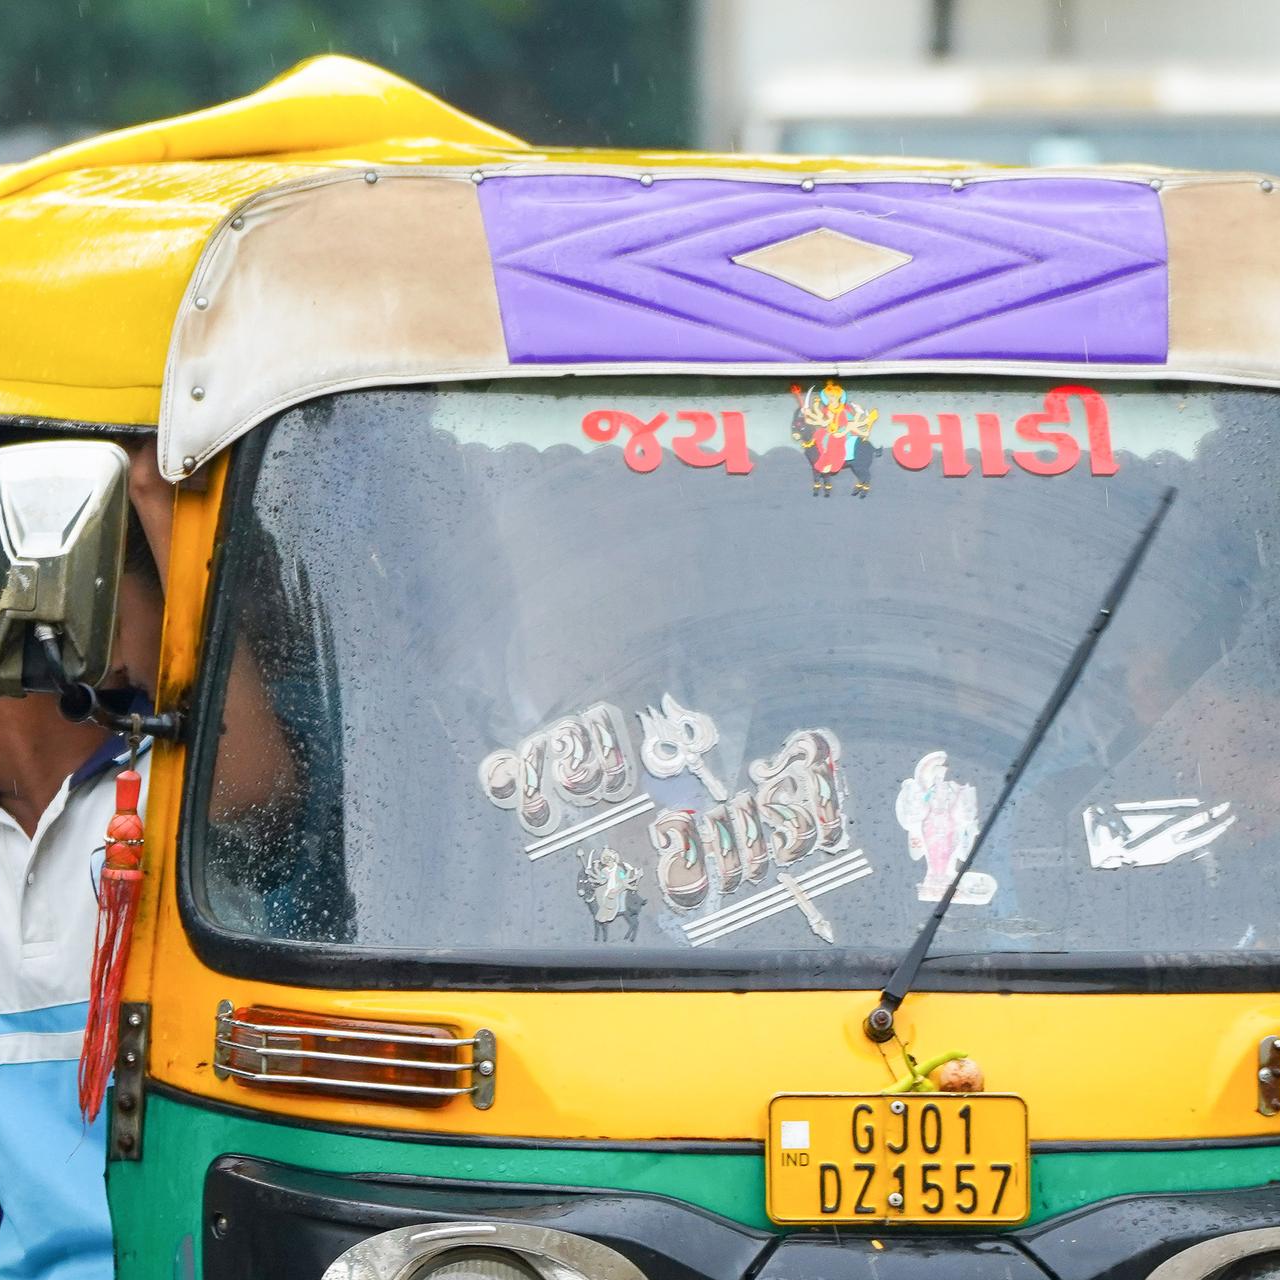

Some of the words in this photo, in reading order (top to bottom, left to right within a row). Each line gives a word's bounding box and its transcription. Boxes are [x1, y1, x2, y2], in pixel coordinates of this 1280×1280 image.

[581, 409, 754, 475] જય
[891, 384, 1120, 478] માડી
[851, 1103, 972, 1155] GJ01
[781, 1152, 810, 1168] IND
[819, 1162, 1012, 1215] DZ1557
